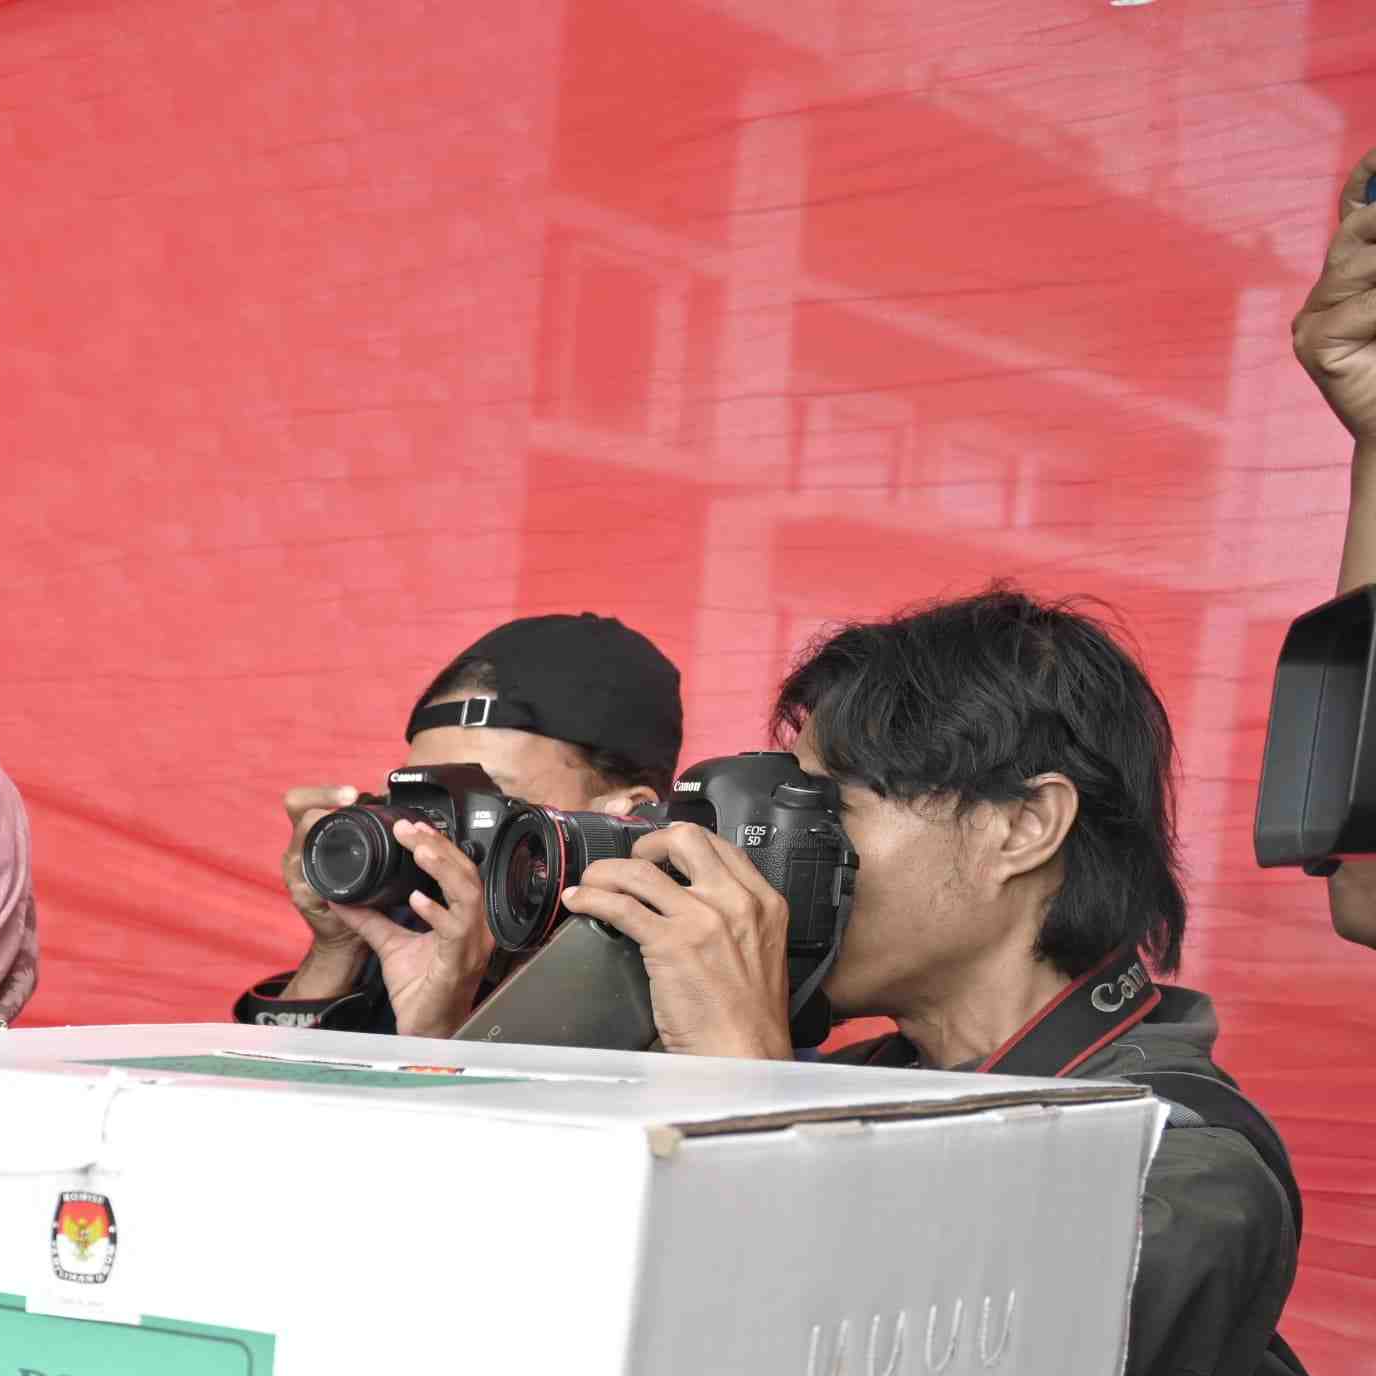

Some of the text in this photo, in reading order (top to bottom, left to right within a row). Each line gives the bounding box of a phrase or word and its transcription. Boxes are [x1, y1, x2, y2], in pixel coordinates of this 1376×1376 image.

[672, 781, 702, 793] Canon
[744, 825, 767, 836] EOS
[747, 836, 762, 847] 5D
